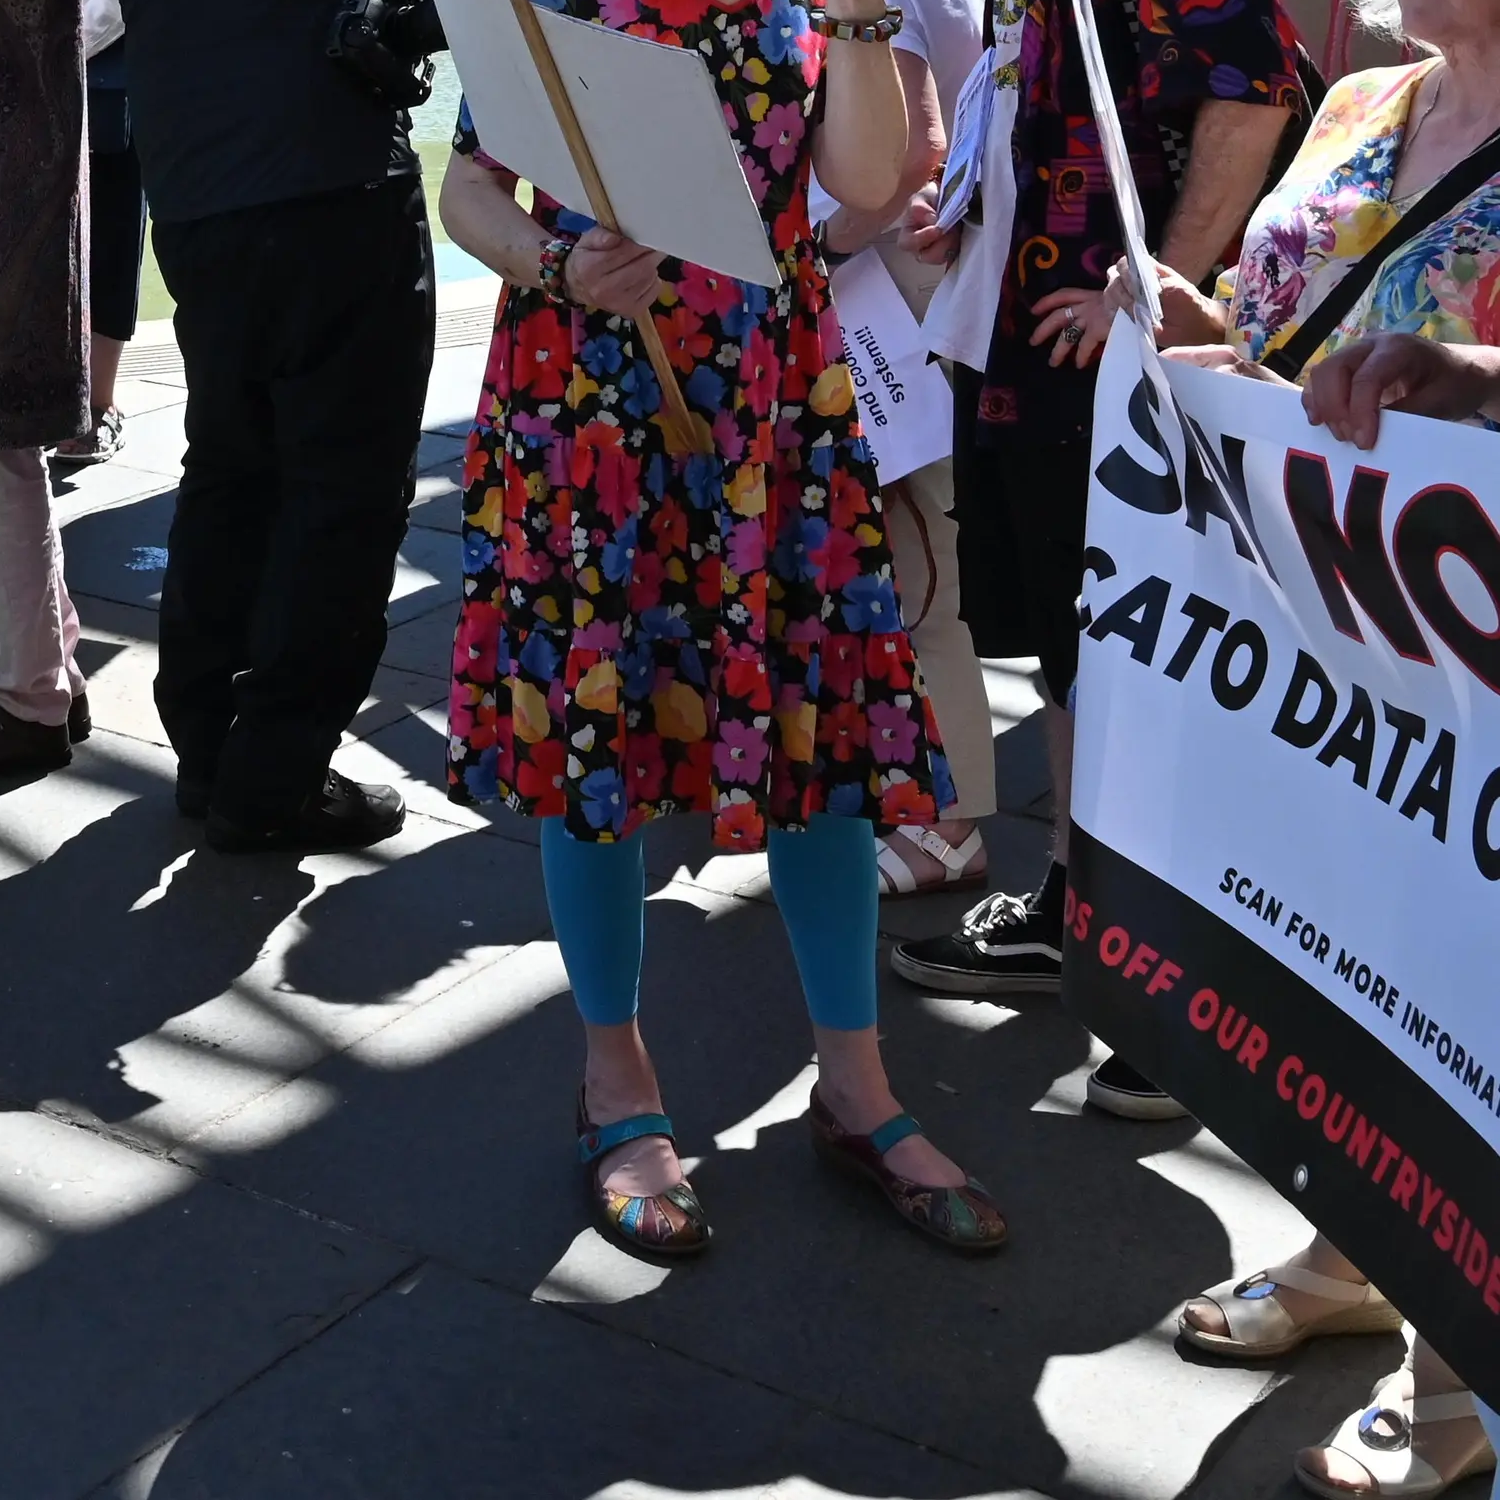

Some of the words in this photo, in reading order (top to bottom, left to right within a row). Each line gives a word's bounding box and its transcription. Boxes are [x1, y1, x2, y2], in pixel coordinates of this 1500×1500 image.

[858, 395, 888, 428] and
[1283, 447, 1500, 695] NO
[1271, 648, 1456, 844] DATA
[1219, 867, 1283, 927] SCAN
[1284, 911, 1331, 964] FOR
[1333, 948, 1400, 1019] MORE
[1099, 926, 1184, 996] OFF
[1188, 988, 1269, 1074] OUR
[1275, 1055, 1500, 1316] COUNTRYSIDE
